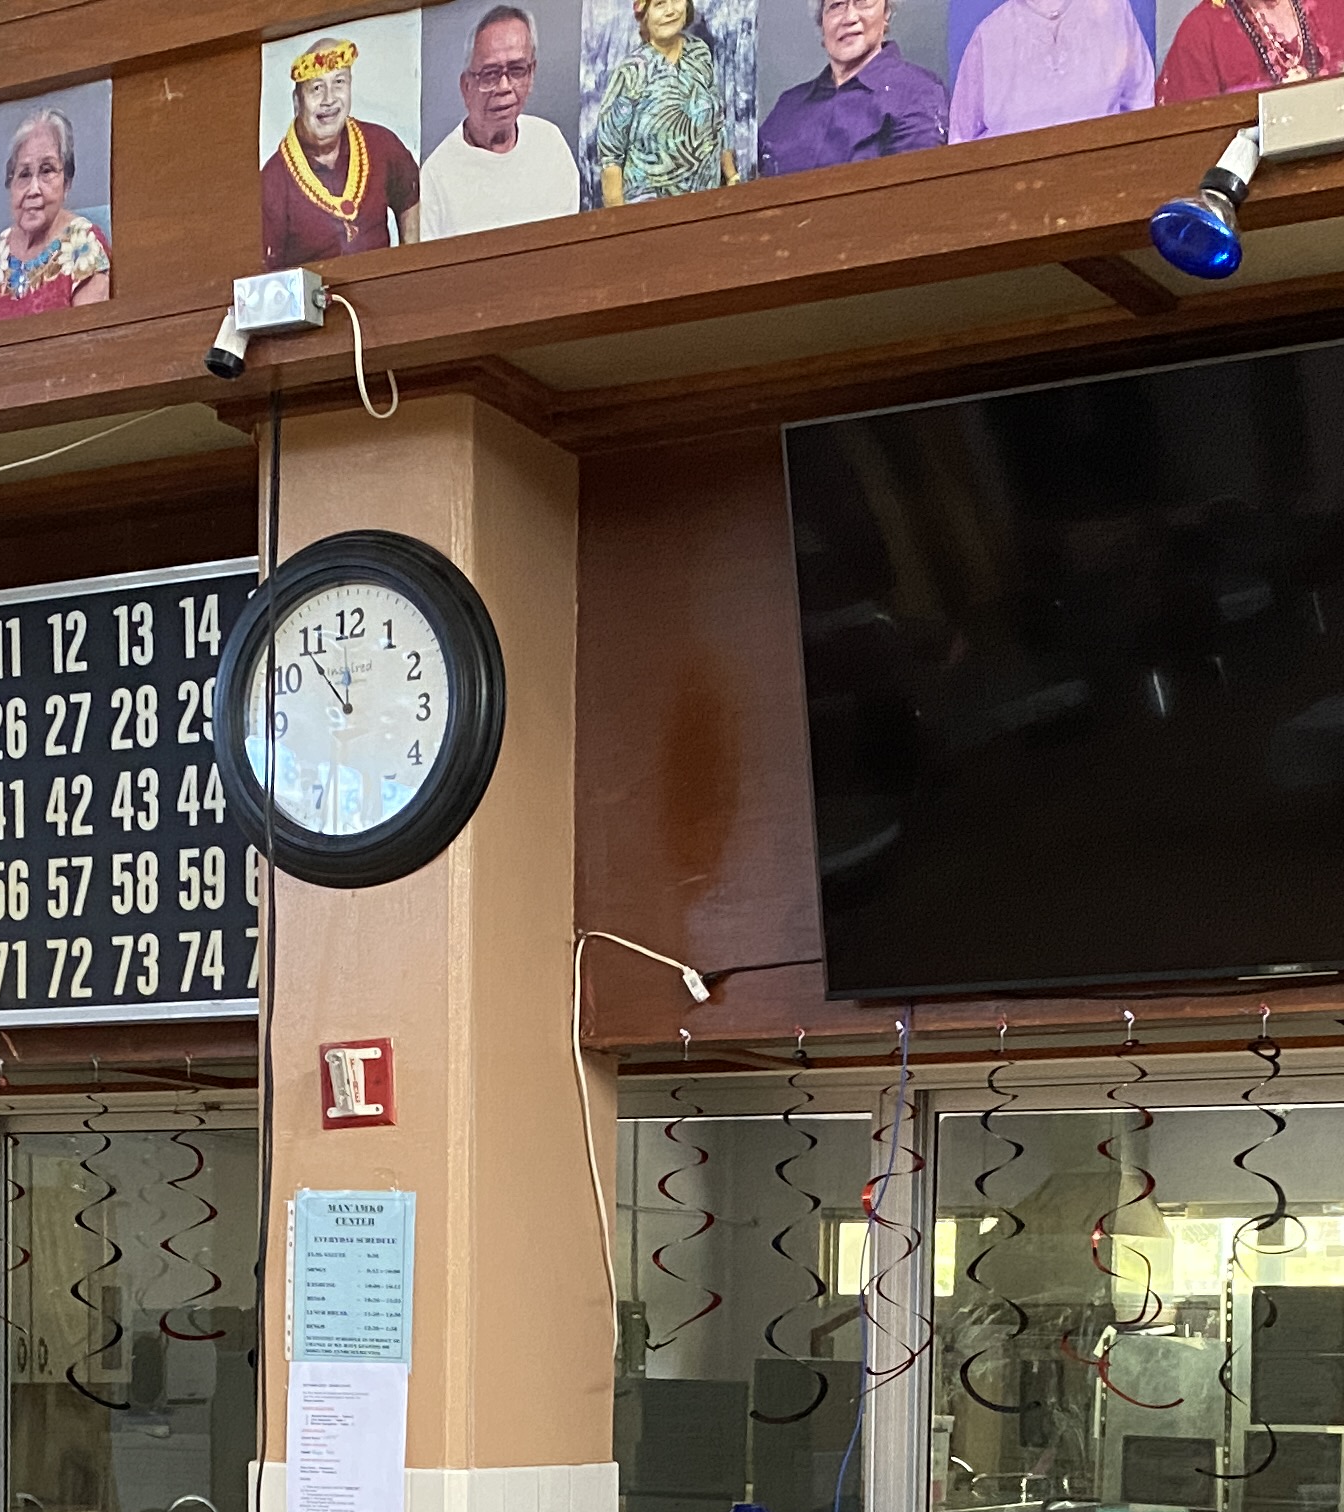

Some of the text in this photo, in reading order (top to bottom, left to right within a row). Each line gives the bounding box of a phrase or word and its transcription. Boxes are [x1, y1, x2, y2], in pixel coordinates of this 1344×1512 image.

[46, 610, 88, 674] 12
[112, 601, 154, 667] 13
[178, 593, 222, 659] 14
[299, 624, 326, 657] 11
[335, 607, 365, 641] 12
[382, 619, 397, 650] 1
[274, 662, 303, 696] 10
[406, 651, 422, 682] 2
[44, 692, 92, 757] 27
[110, 684, 159, 751] 28
[415, 692, 431, 722] 3
[406, 739, 422, 766] 4
[45, 774, 94, 837] 42
[110, 767, 159, 832] 43
[176, 762, 227, 827] 44
[312, 785, 324, 810] 7
[47, 855, 93, 919] 57
[111, 850, 159, 915] 58
[178, 845, 226, 911] 59
[46, 936, 93, 999] 72
[111, 932, 160, 996] 73
[178, 929, 225, 993] 74
